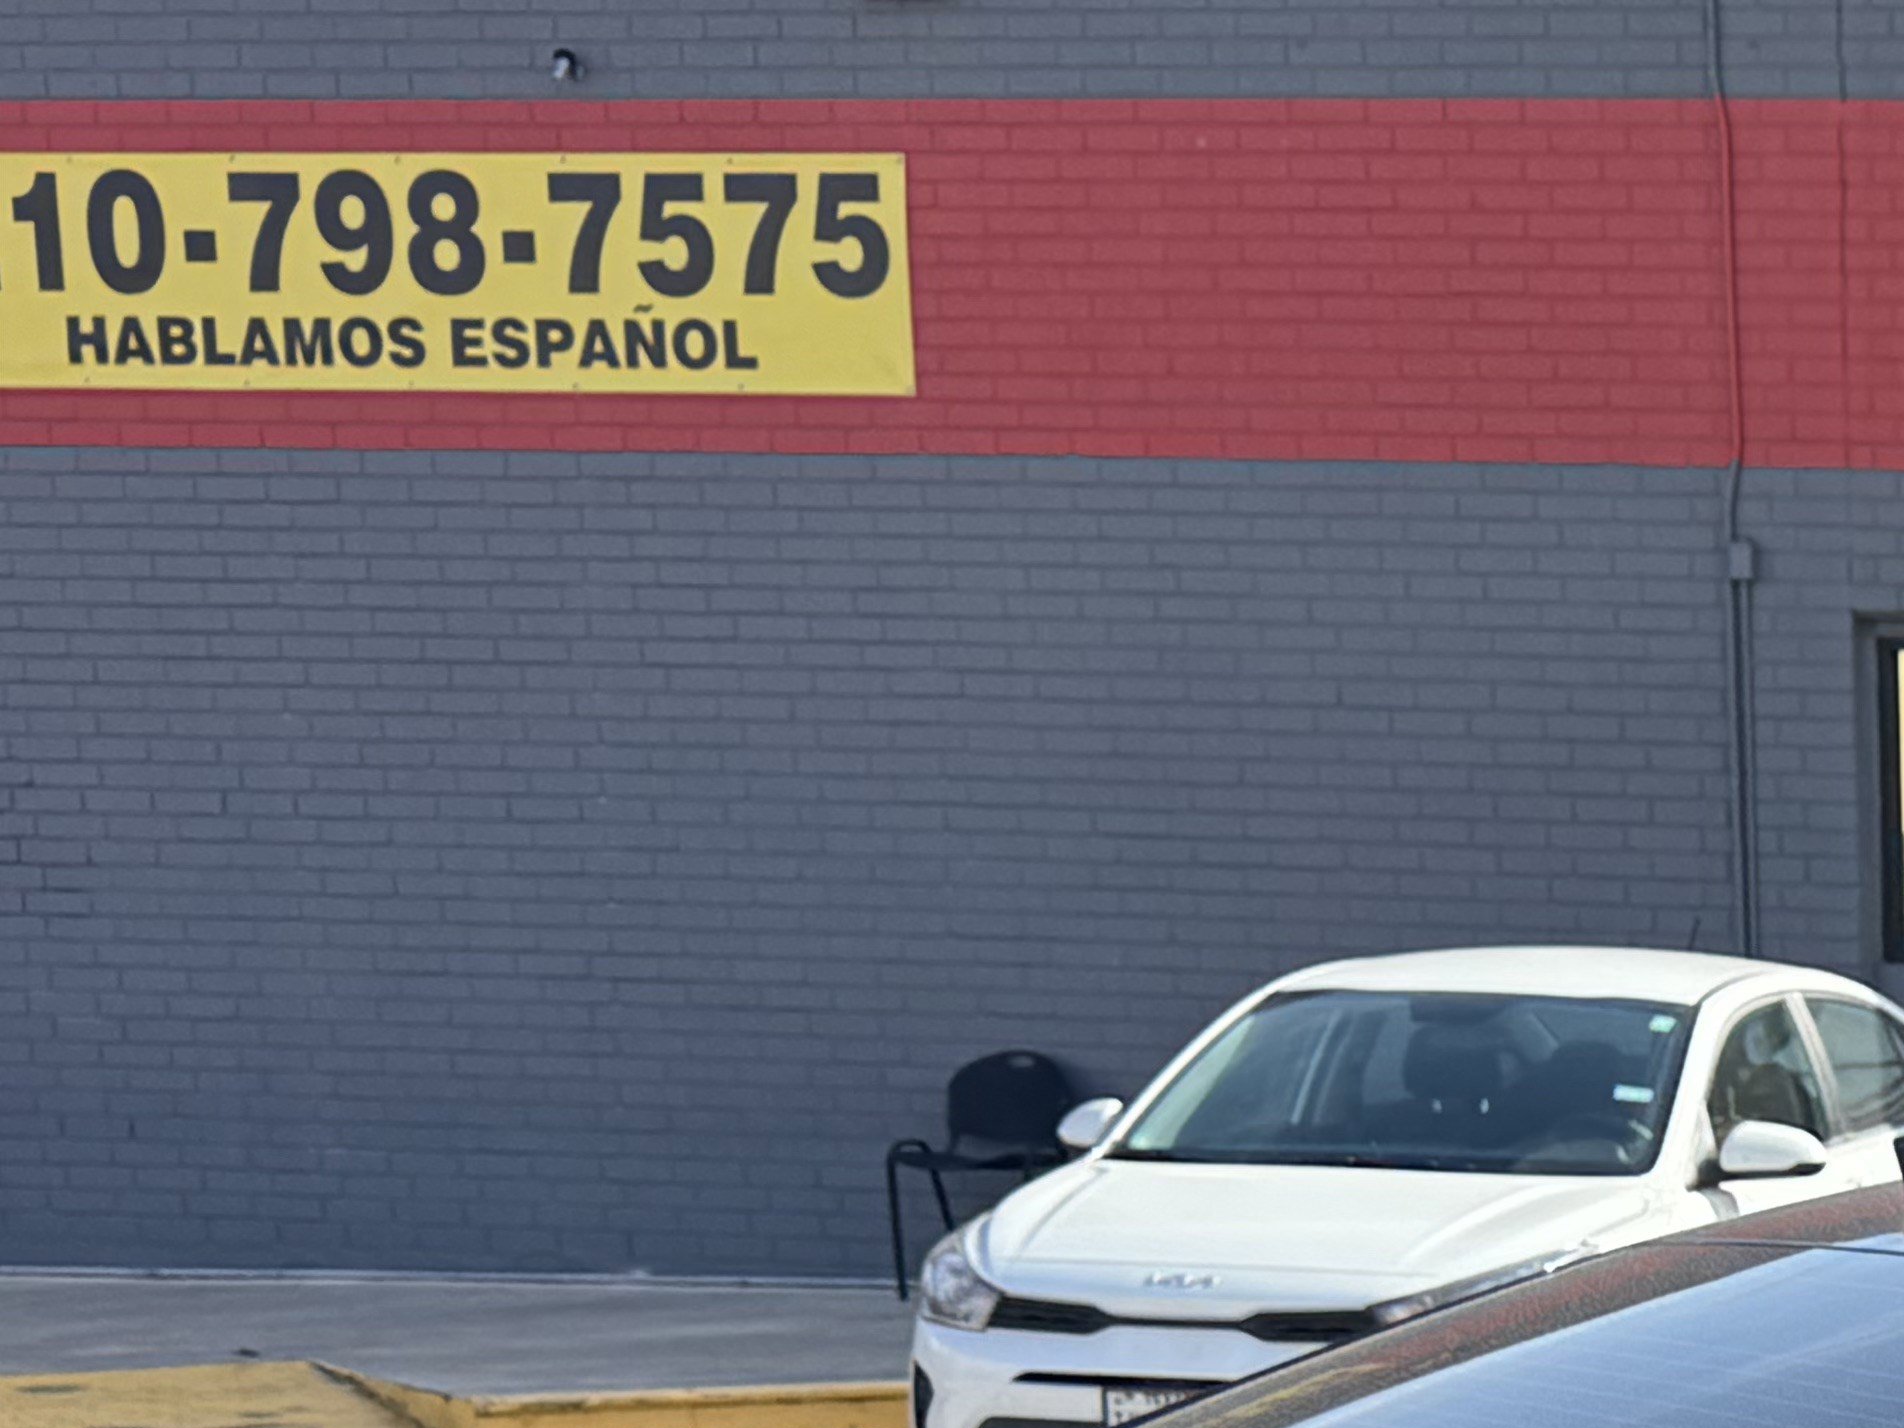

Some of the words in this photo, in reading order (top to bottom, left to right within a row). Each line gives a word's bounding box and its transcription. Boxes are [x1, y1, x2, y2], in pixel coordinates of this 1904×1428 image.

[0, 168, 891, 299] 10-798-7575
[66, 314, 428, 368] HABLAMOS
[450, 304, 760, 371] ESPAÑOL
